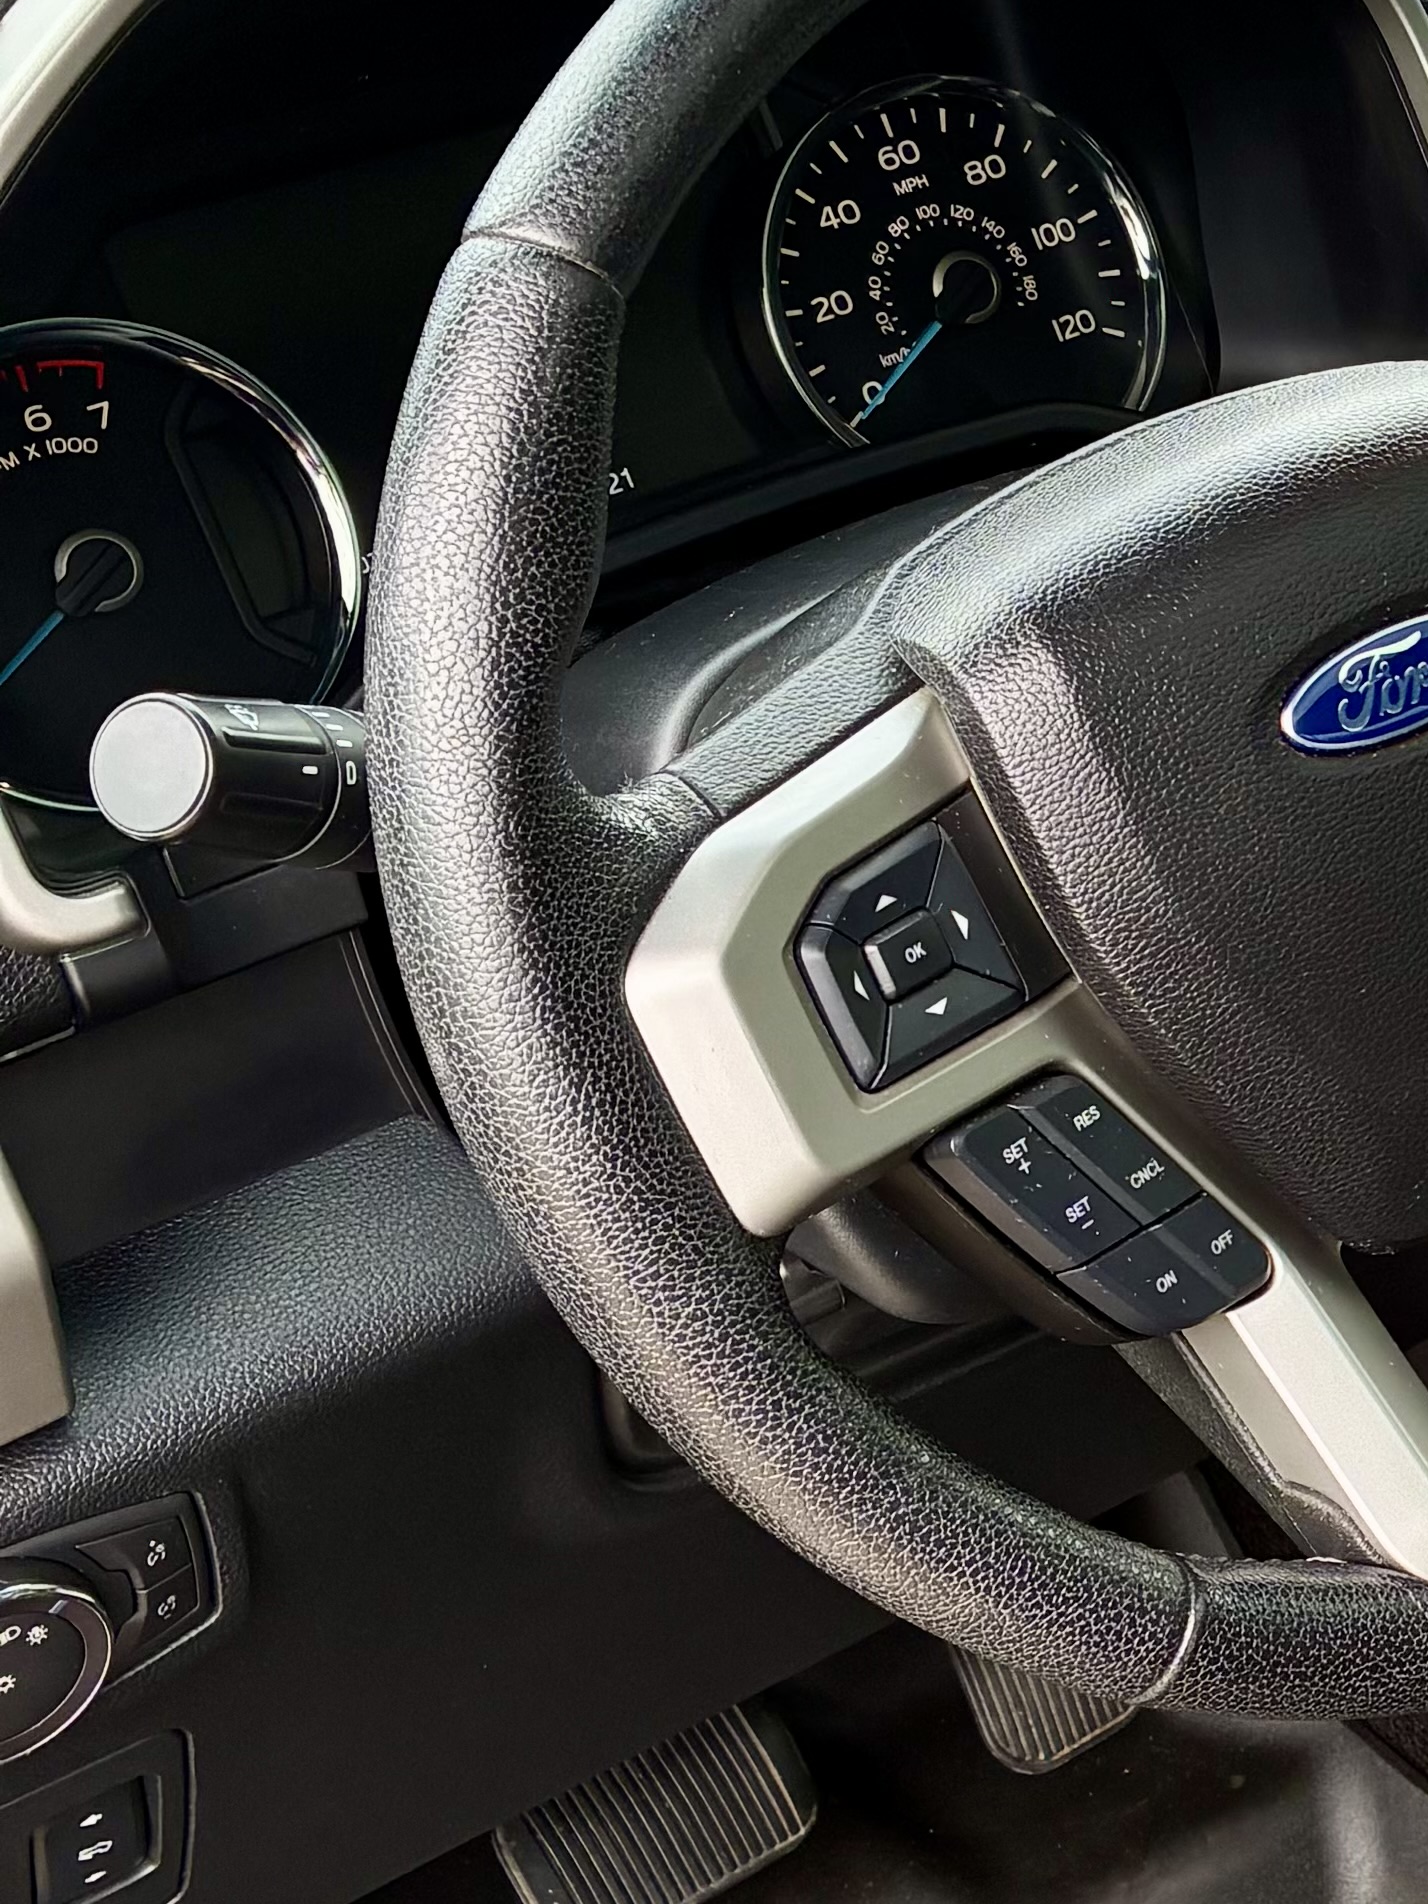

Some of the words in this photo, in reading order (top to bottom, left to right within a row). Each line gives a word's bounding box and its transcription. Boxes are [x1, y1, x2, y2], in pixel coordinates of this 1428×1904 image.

[878, 139, 921, 171] 60
[963, 154, 1007, 186] 80
[892, 174, 930, 196] MPH
[820, 199, 861, 229] 40
[915, 203, 940, 220] 100
[950, 204, 975, 221] 120
[887, 215, 910, 238] 80
[981, 216, 1006, 239] 140
[1030, 218, 1077, 251] 100
[871, 240, 889, 266] 60
[1006, 240, 1028, 267] 160
[868, 276, 882, 301] 40
[1022, 274, 1039, 301] 180
[810, 290, 854, 324] 20
[875, 312, 895, 335] 20
[1051, 309, 1096, 343] 120
[24, 404, 52, 432] 6
[86, 400, 109, 430] 7
[0, 451, 20, 471] M
[23, 442, 41, 461] X
[46, 437, 98, 455] 1000
[905, 942, 927, 963] OK
[1073, 1105, 1101, 1131] RES
[1003, 1137, 1029, 1164] SET
[1130, 1158, 1165, 1189] CNCL
[1065, 1196, 1091, 1223] SET
[1210, 1230, 1234, 1255] OFF
[1156, 1270, 1178, 1293] ON
